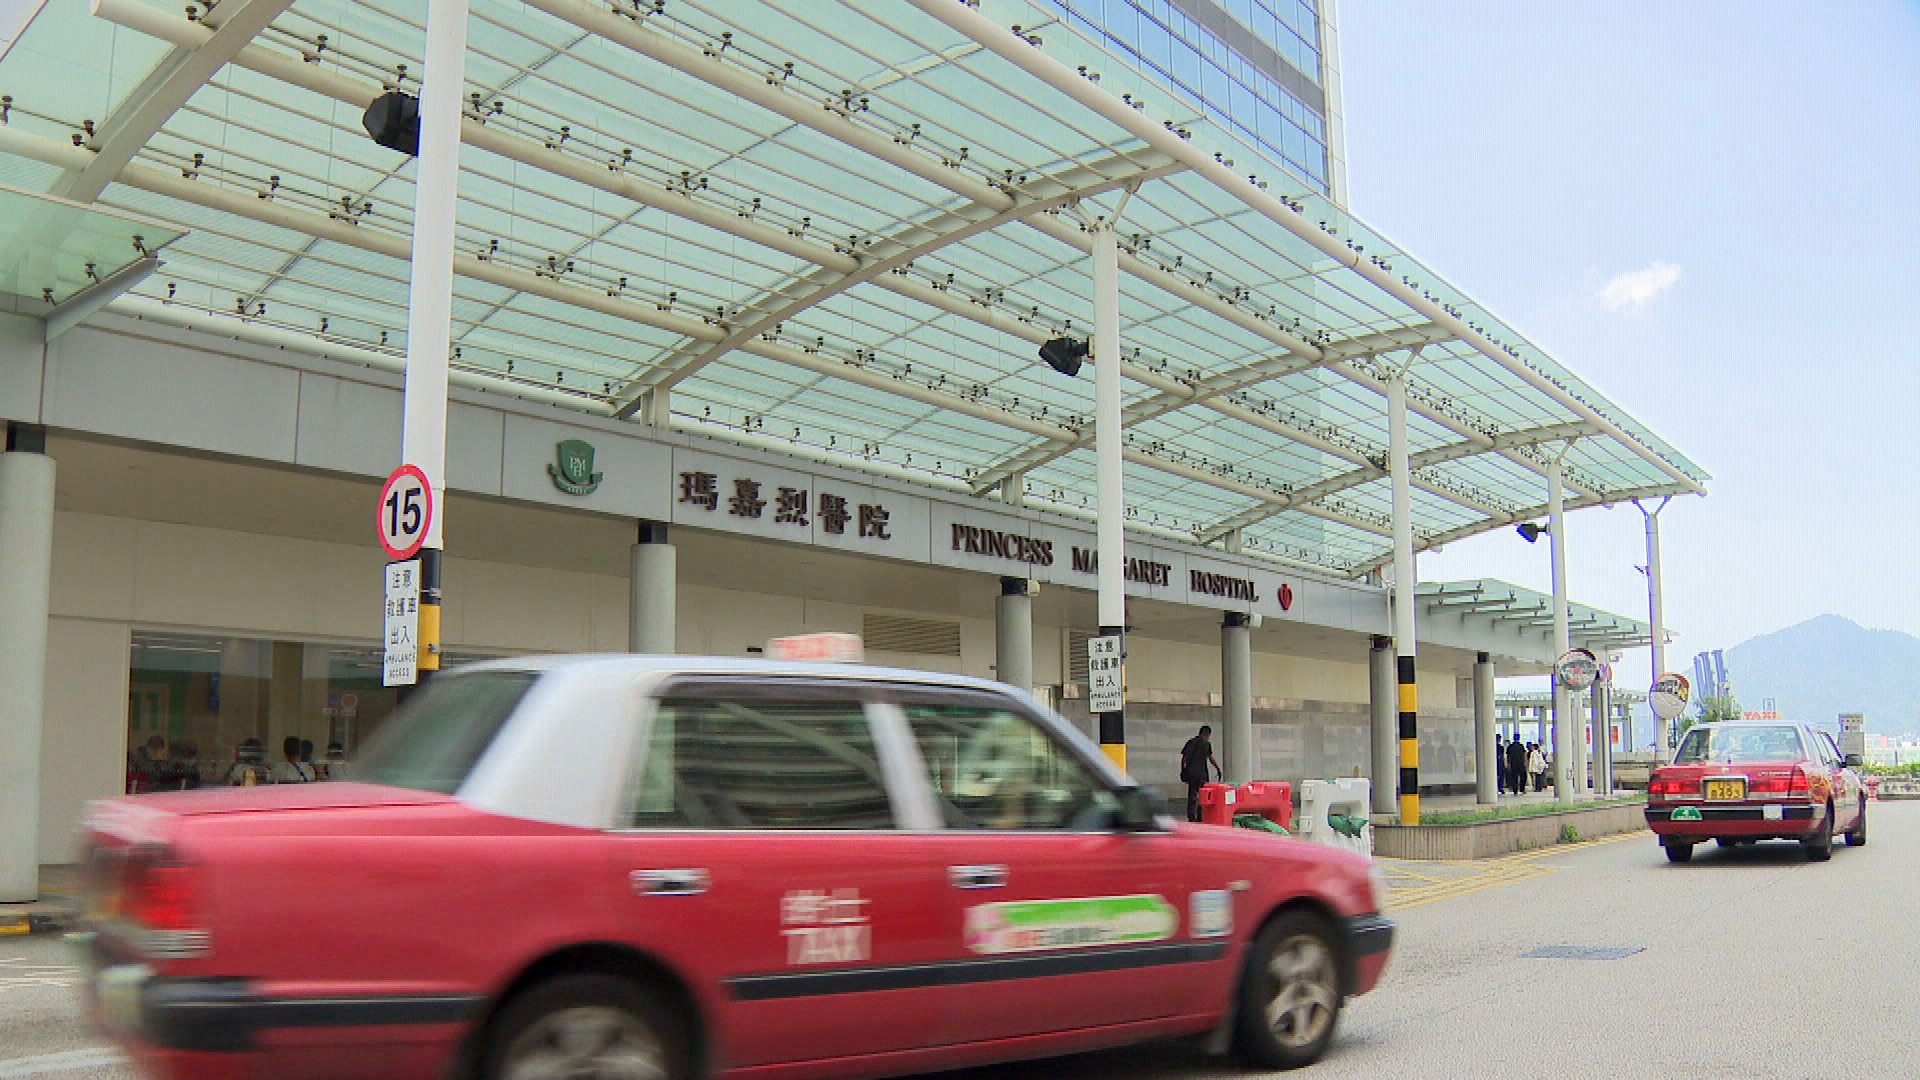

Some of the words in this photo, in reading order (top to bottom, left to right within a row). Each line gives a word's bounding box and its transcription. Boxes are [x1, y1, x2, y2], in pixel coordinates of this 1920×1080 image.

[386, 487, 421, 537] 15
[678, 471, 891, 540] 瑪嘉烈醫院
[951, 523, 1054, 566] PRINCESS
[1190, 569, 1260, 602] HOSPITAL
[391, 625, 410, 645] 出入
[1096, 675, 1115, 688] 出入
